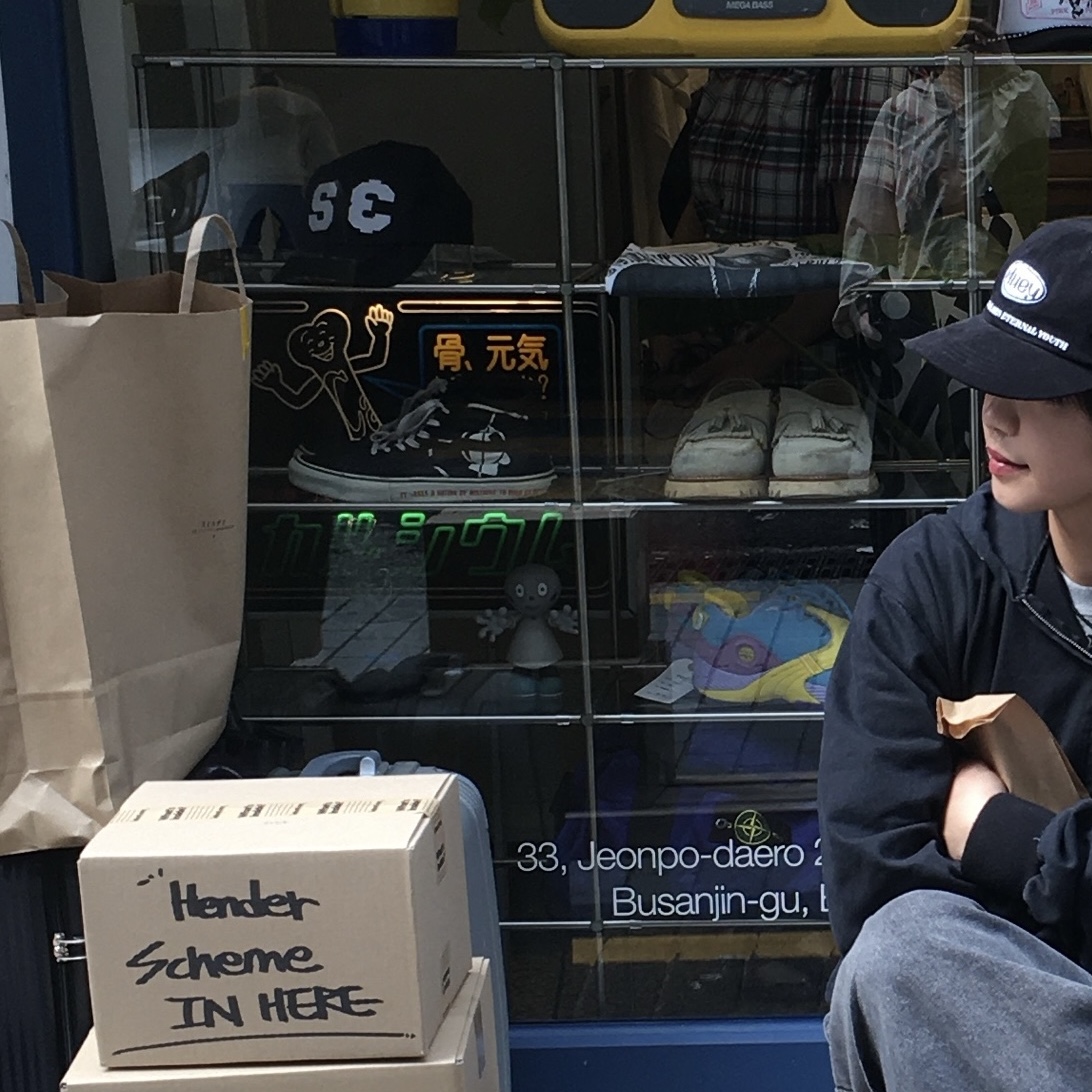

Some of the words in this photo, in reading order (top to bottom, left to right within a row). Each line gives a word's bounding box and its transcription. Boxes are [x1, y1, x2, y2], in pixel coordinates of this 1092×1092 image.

[726, 1, 751, 9] MEGA
[751, 1, 774, 9] BASS
[999, 311, 1038, 338] ETERNAL
[1037, 328, 1070, 352] YOUTH
[516, 842, 567, 875] 33,
[577, 839, 805, 876] Jeonpo-daero
[169, 879, 320, 921] Hender
[612, 886, 809, 921] Busanjin-gu,
[126, 941, 324, 985] Scheme
[164, 996, 244, 1029] IN
[258, 985, 384, 1023] HERE
